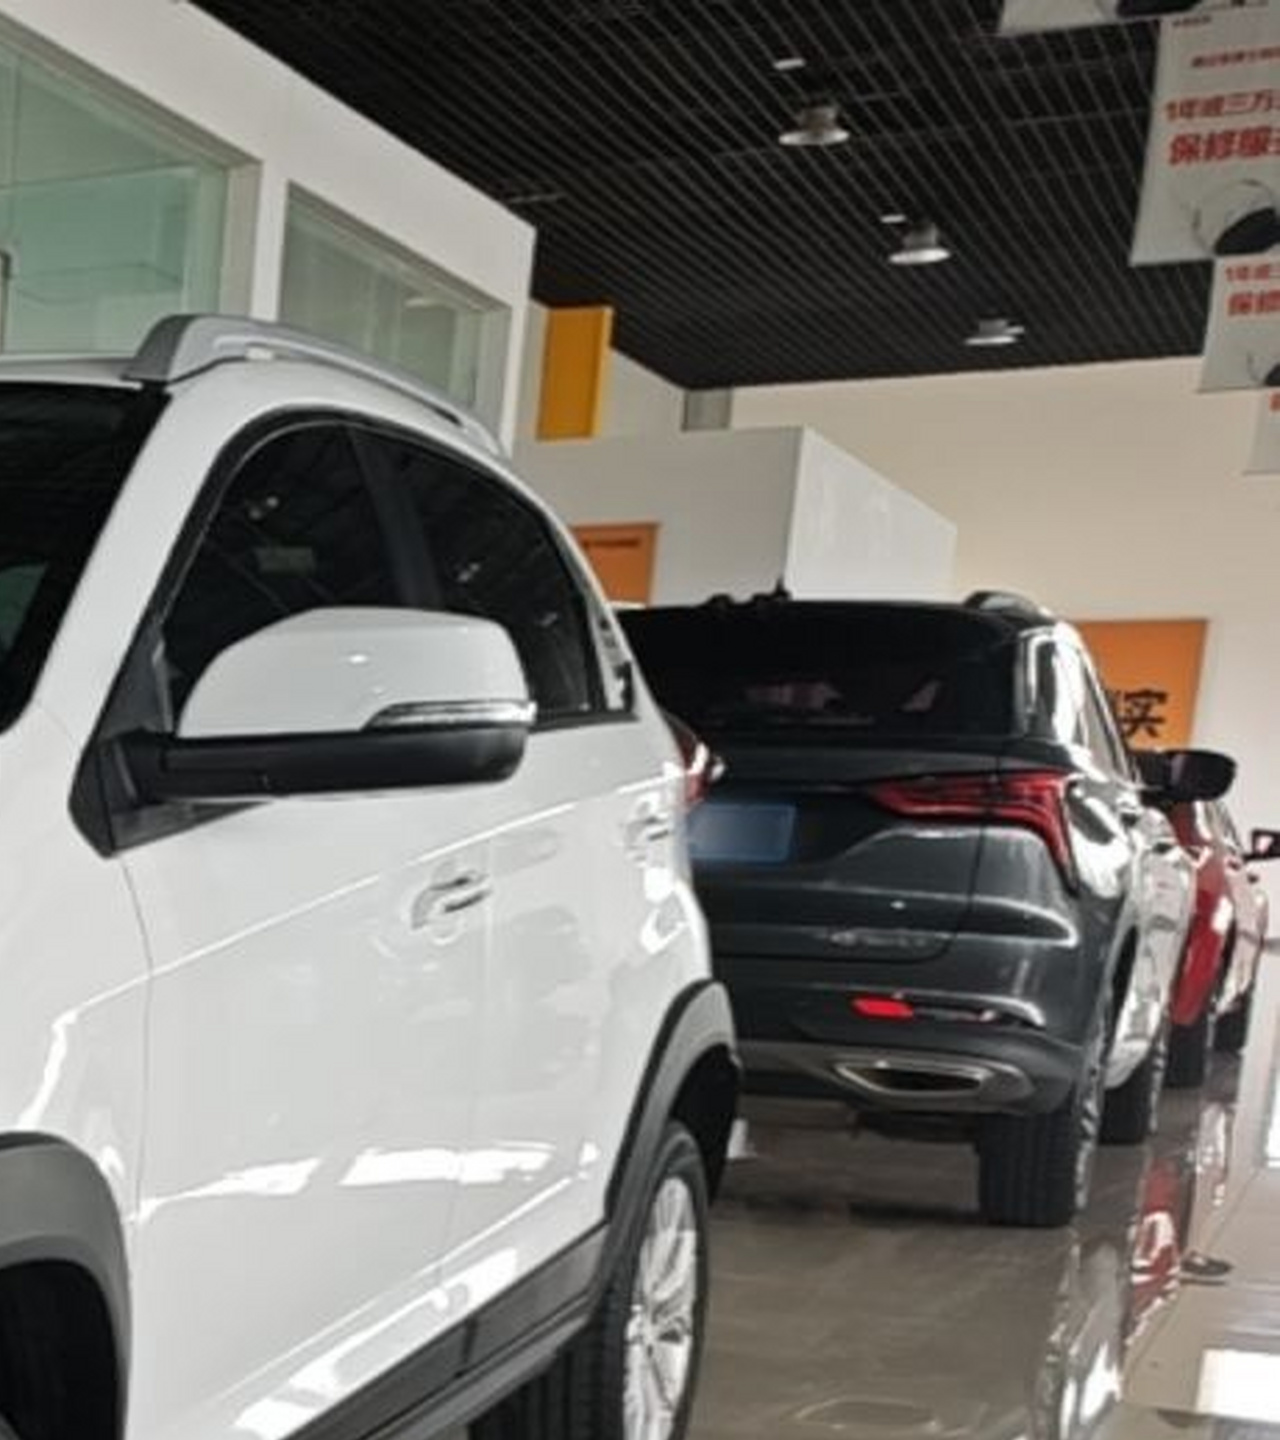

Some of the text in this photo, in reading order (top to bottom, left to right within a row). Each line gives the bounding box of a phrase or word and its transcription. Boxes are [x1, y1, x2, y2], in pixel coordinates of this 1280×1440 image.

[1168, 126, 1280, 166] 保修服
[1106, 688, 1168, 740] 实
